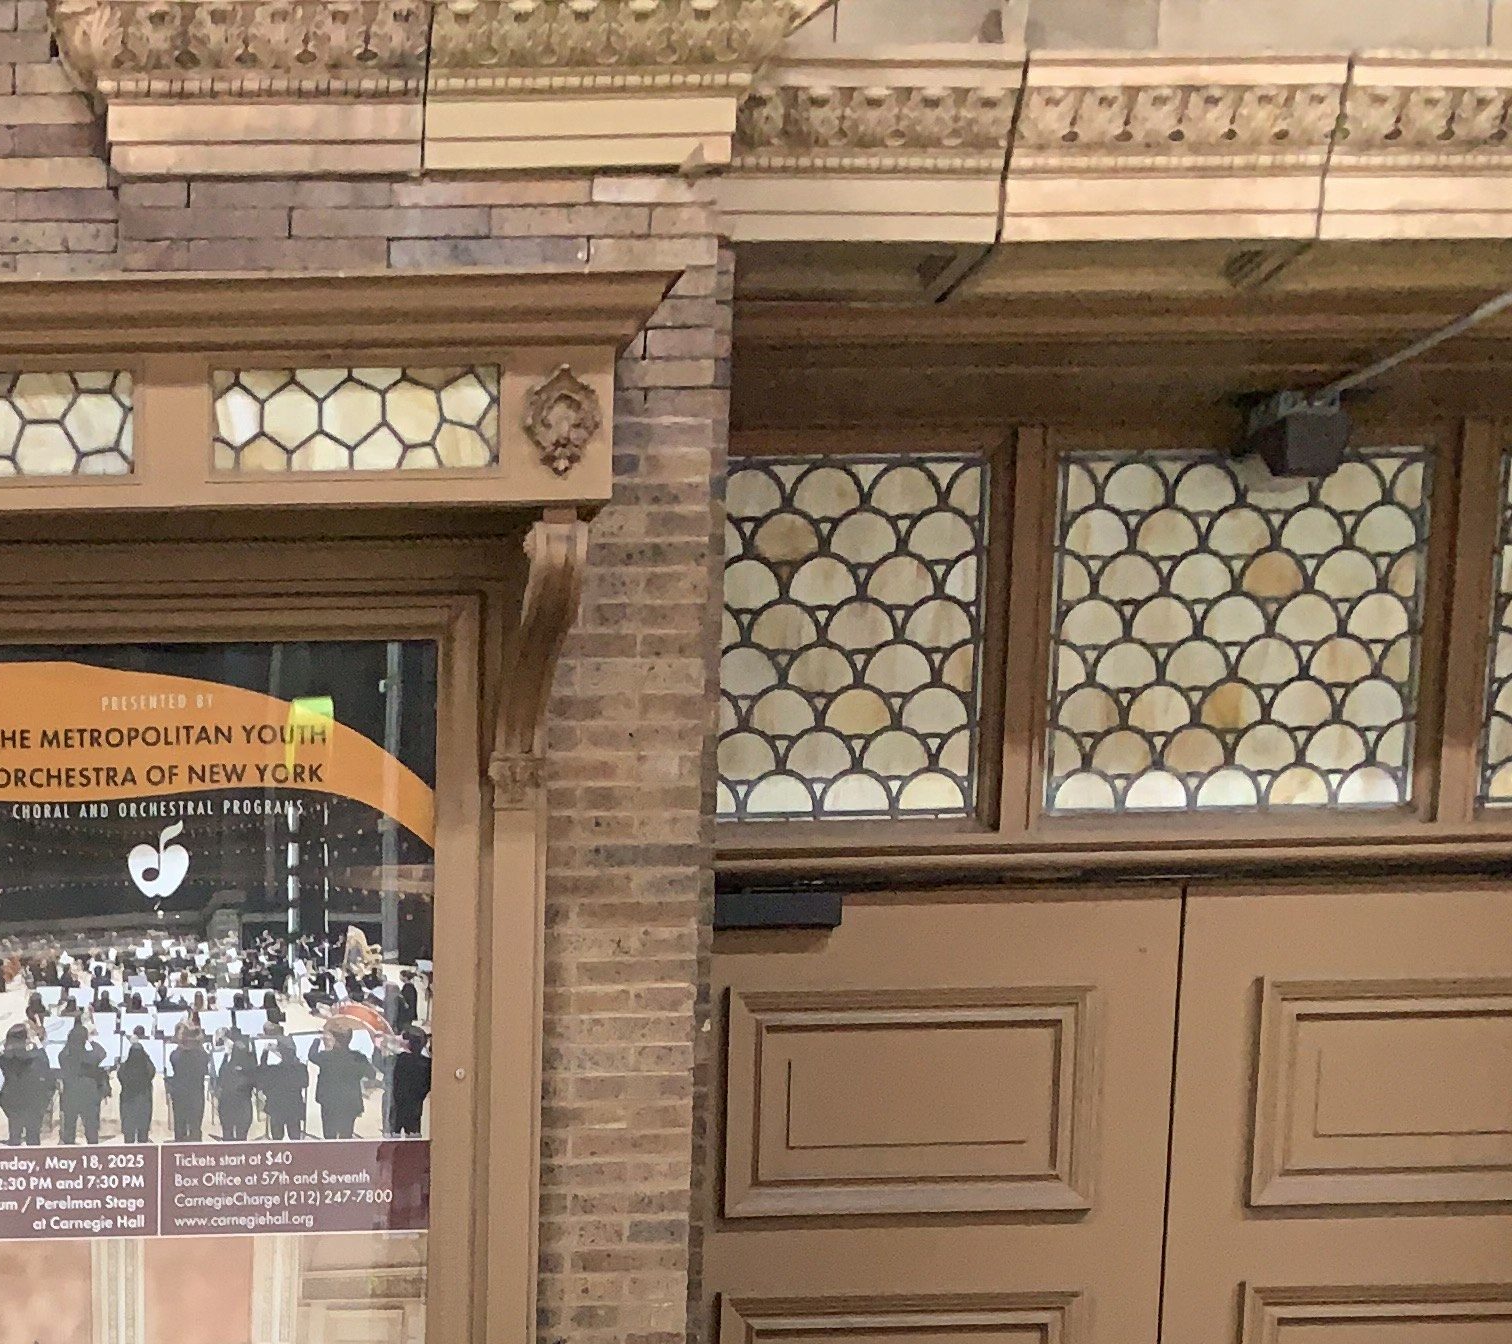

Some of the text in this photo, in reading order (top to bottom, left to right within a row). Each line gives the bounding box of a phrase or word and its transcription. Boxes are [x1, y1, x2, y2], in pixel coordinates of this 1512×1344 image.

[101, 694, 214, 711] PRESENTED BY
[40, 725, 233, 750] METROPOLITAN
[241, 724, 327, 745] YOUTH
[146, 765, 179, 787] OF
[188, 763, 247, 785] NEW
[255, 763, 324, 784] YORK
[12, 799, 304, 819] CHORAL AND ORCHESTRAL PROGRAMS
[45, 1155, 76, 1172] May
[81, 1155, 103, 1170] 18,
[108, 1154, 144, 1169] 2025
[174, 1150, 292, 1168] Tickets start at $40
[29, 1176, 52, 1190] PM
[56, 1175, 83, 1190] and
[87, 1175, 119, 1189] 7:30
[122, 1174, 145, 1188] PM
[174, 1168, 370, 1187] Box Office at 57th and Seventh
[21, 1196, 31, 1213] /
[36, 1195, 101, 1211] Perelman
[105, 1194, 144, 1212] Stage
[174, 1188, 393, 1210] CarnegieCharge (212) 247-7800
[33, 1214, 144, 1232] at Carnegie Hall
[174, 1211, 314, 1228] www.carnegiehall.org
